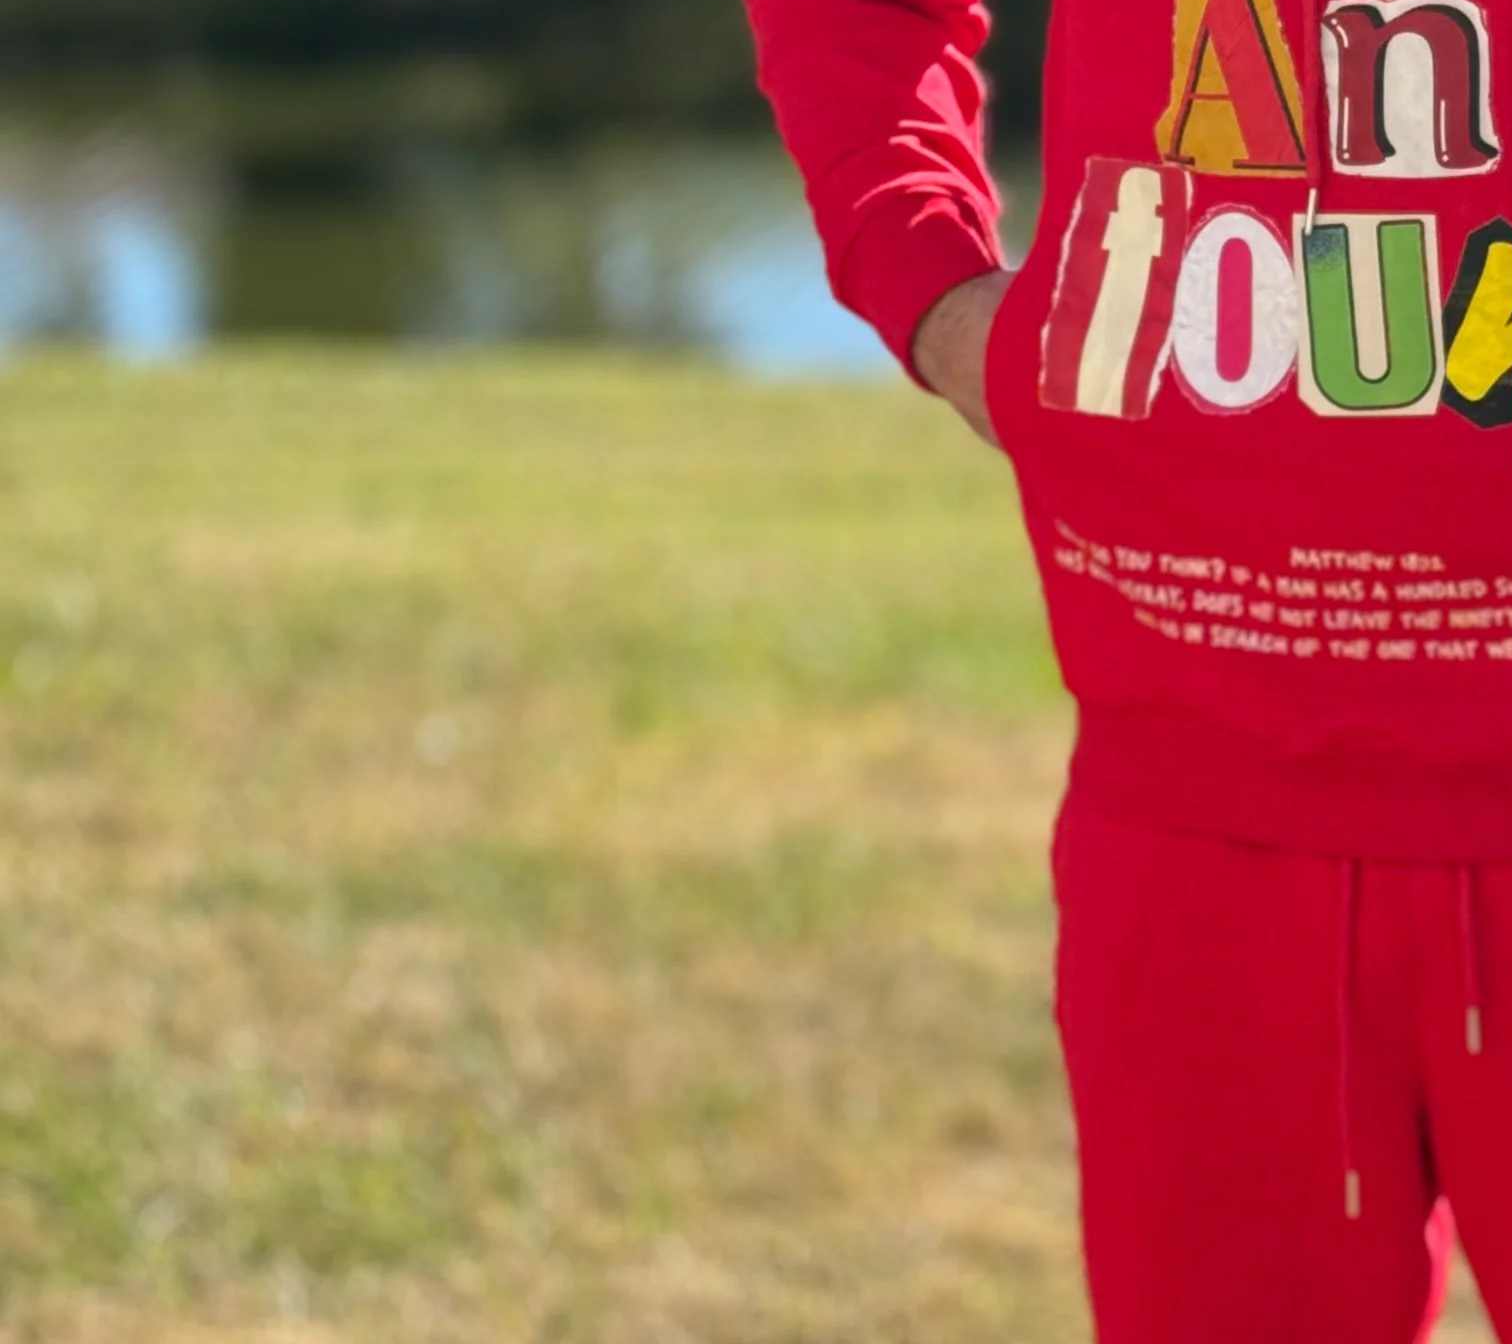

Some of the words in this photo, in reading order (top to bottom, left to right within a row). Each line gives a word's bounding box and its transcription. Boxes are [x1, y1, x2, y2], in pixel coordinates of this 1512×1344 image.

[1114, 545, 1153, 571] YOU
[1257, 573, 1272, 592] A
[1276, 577, 1317, 599] MAN
[1323, 579, 1365, 601] HAS
[1371, 581, 1389, 601] A
[1395, 579, 1488, 601] HUNDRED
[1290, 547, 1394, 571] MATTHEW
[1192, 589, 1244, 618] DOES
[1278, 607, 1316, 628] NOT
[1323, 609, 1391, 630] LEAVE
[1400, 609, 1442, 630] THE
[1210, 624, 1288, 655] SEARCH
[1292, 637, 1321, 657] OF
[1329, 639, 1370, 660] THE
[1376, 639, 1417, 660] ONE
[1424, 640, 1478, 660] THAT
